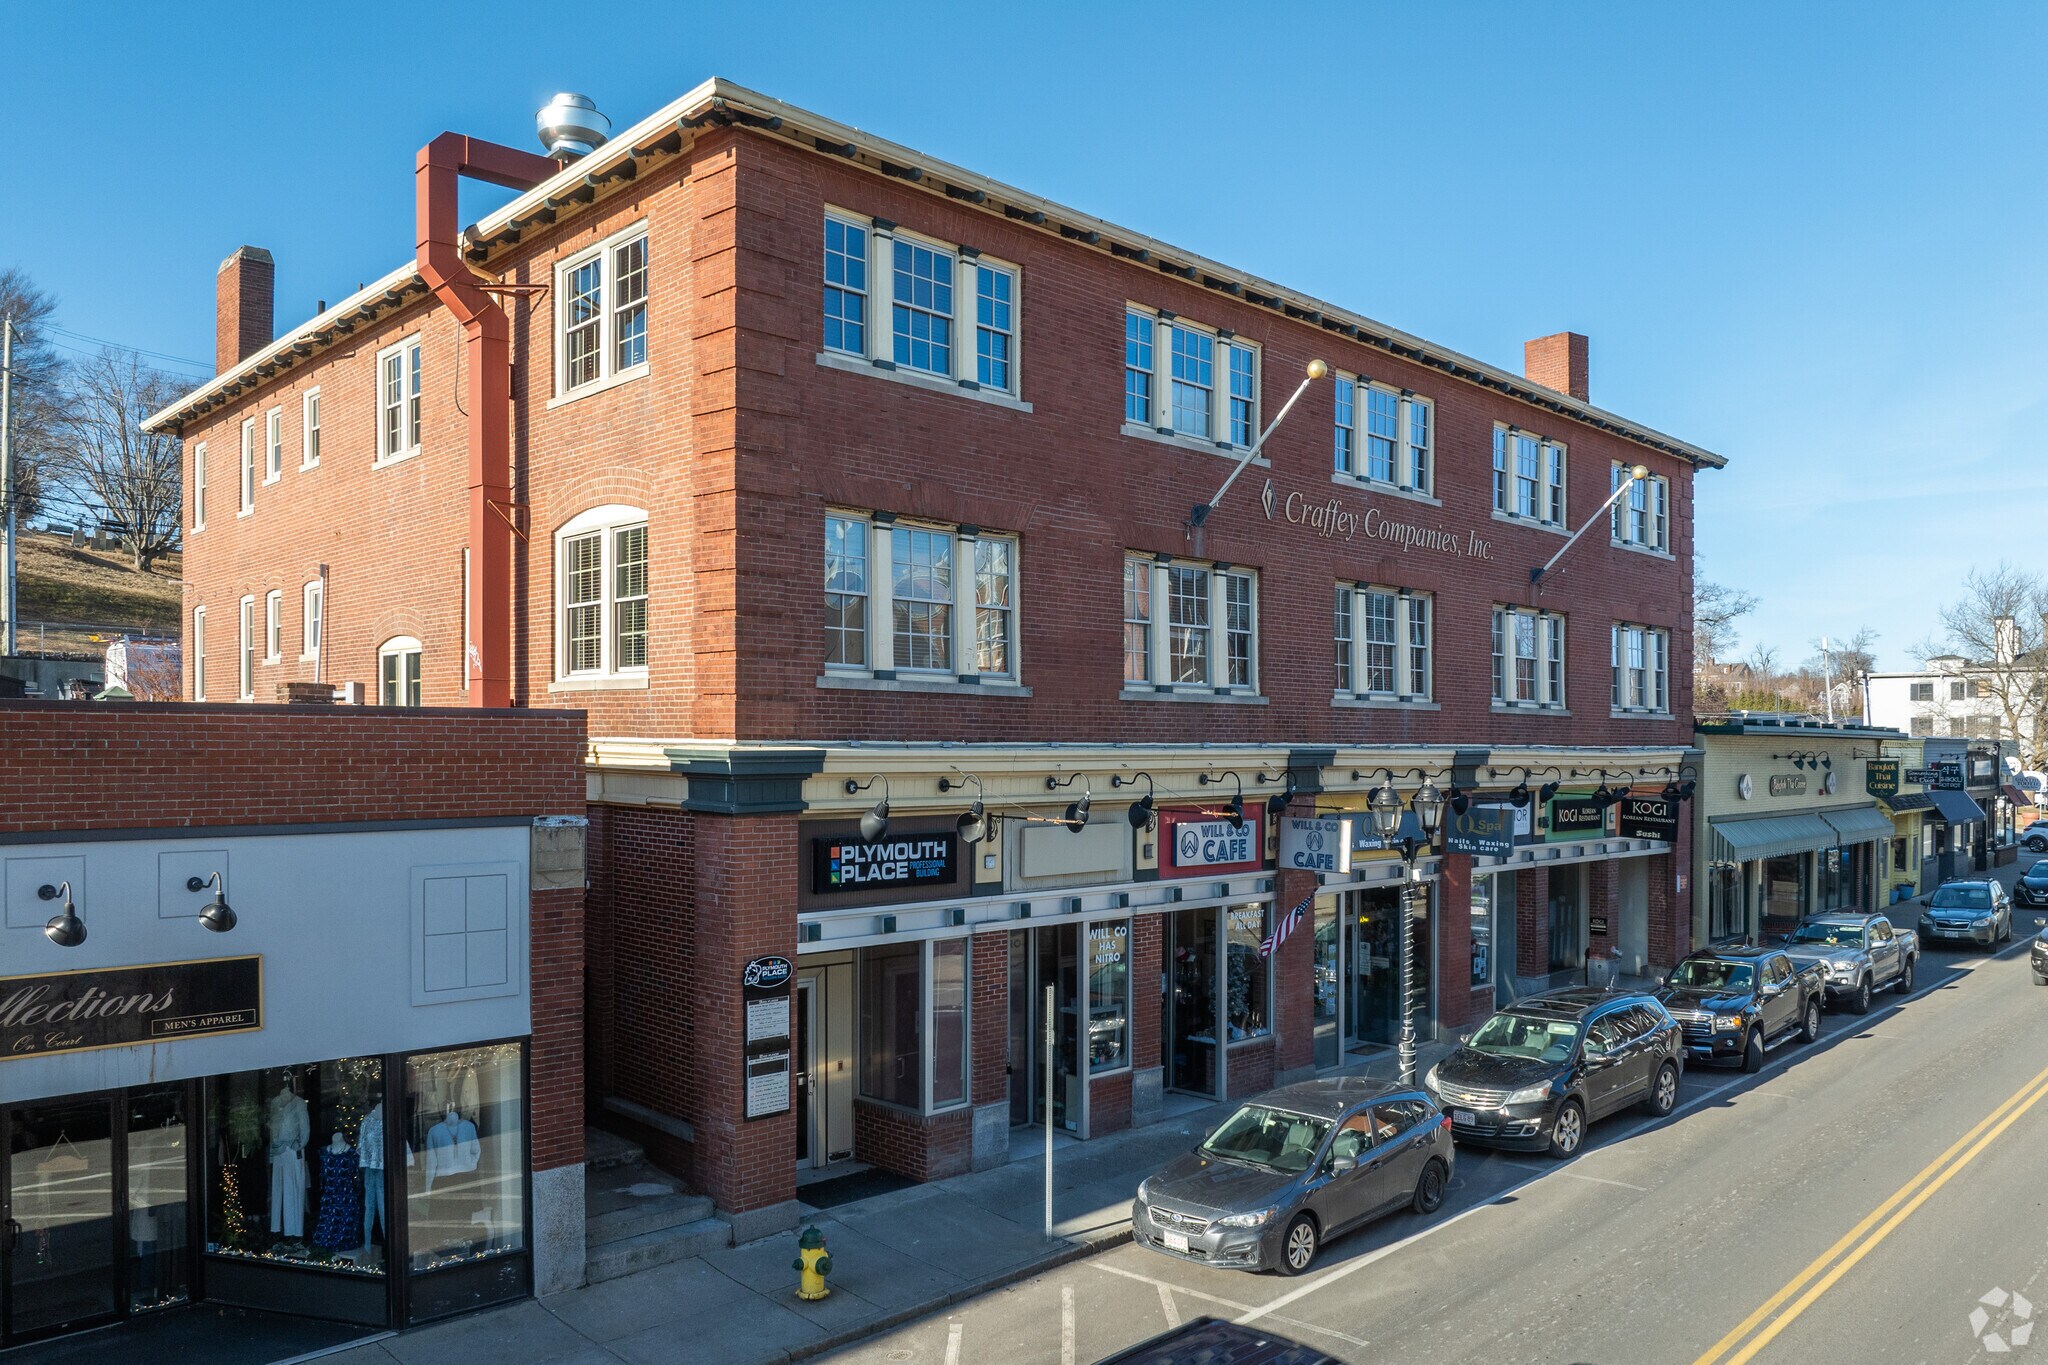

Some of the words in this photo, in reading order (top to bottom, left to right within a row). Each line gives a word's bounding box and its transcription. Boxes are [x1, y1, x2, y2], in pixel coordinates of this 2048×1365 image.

[1285, 491, 1358, 541] Craffey
[1364, 508, 1461, 557] Companies,
[1466, 530, 1494, 560] Inc.
[1868, 763, 1896, 772] Bangkok
[1875, 772, 1891, 780] Thai
[1869, 782, 1896, 790] Cuisine
[1632, 801, 1667, 816] KOGI
[1558, 808, 1578, 822] KOGI
[1201, 824, 1225, 838] WILL
[1226, 823, 1234, 837] &
[1292, 819, 1314, 831] WILL
[1315, 821, 1323, 831] &
[1325, 822, 1339, 832] CO
[1478, 820, 1503, 832] Spa
[1636, 830, 1661, 839] Sushi
[1359, 839, 1382, 849] Waxing
[1479, 840, 1510, 848] Waxing
[841, 841, 947, 864] PLYMOUTH
[1203, 838, 1247, 863] CAFE
[909, 859, 946, 869] PROFESSIONAL
[1293, 851, 1334, 870] CAFE
[841, 861, 909, 884] PLACE
[915, 868, 940, 878] BUILDING
[1230, 909, 1265, 920] BREAKFAST
[1235, 921, 1246, 930] ALL
[1247, 920, 1261, 929] DAY
[1088, 927, 1111, 940] WILL
[1114, 926, 1127, 937] CO
[1099, 940, 1116, 951] HAS
[1095, 952, 1121, 964] NITRO
[762, 969, 788, 977] PLACE
[164, 1019, 197, 1031] MEN'S
[199, 1014, 244, 1026] APPAREL
[13, 1034, 35, 1052] On
[44, 1031, 83, 1049] Court
